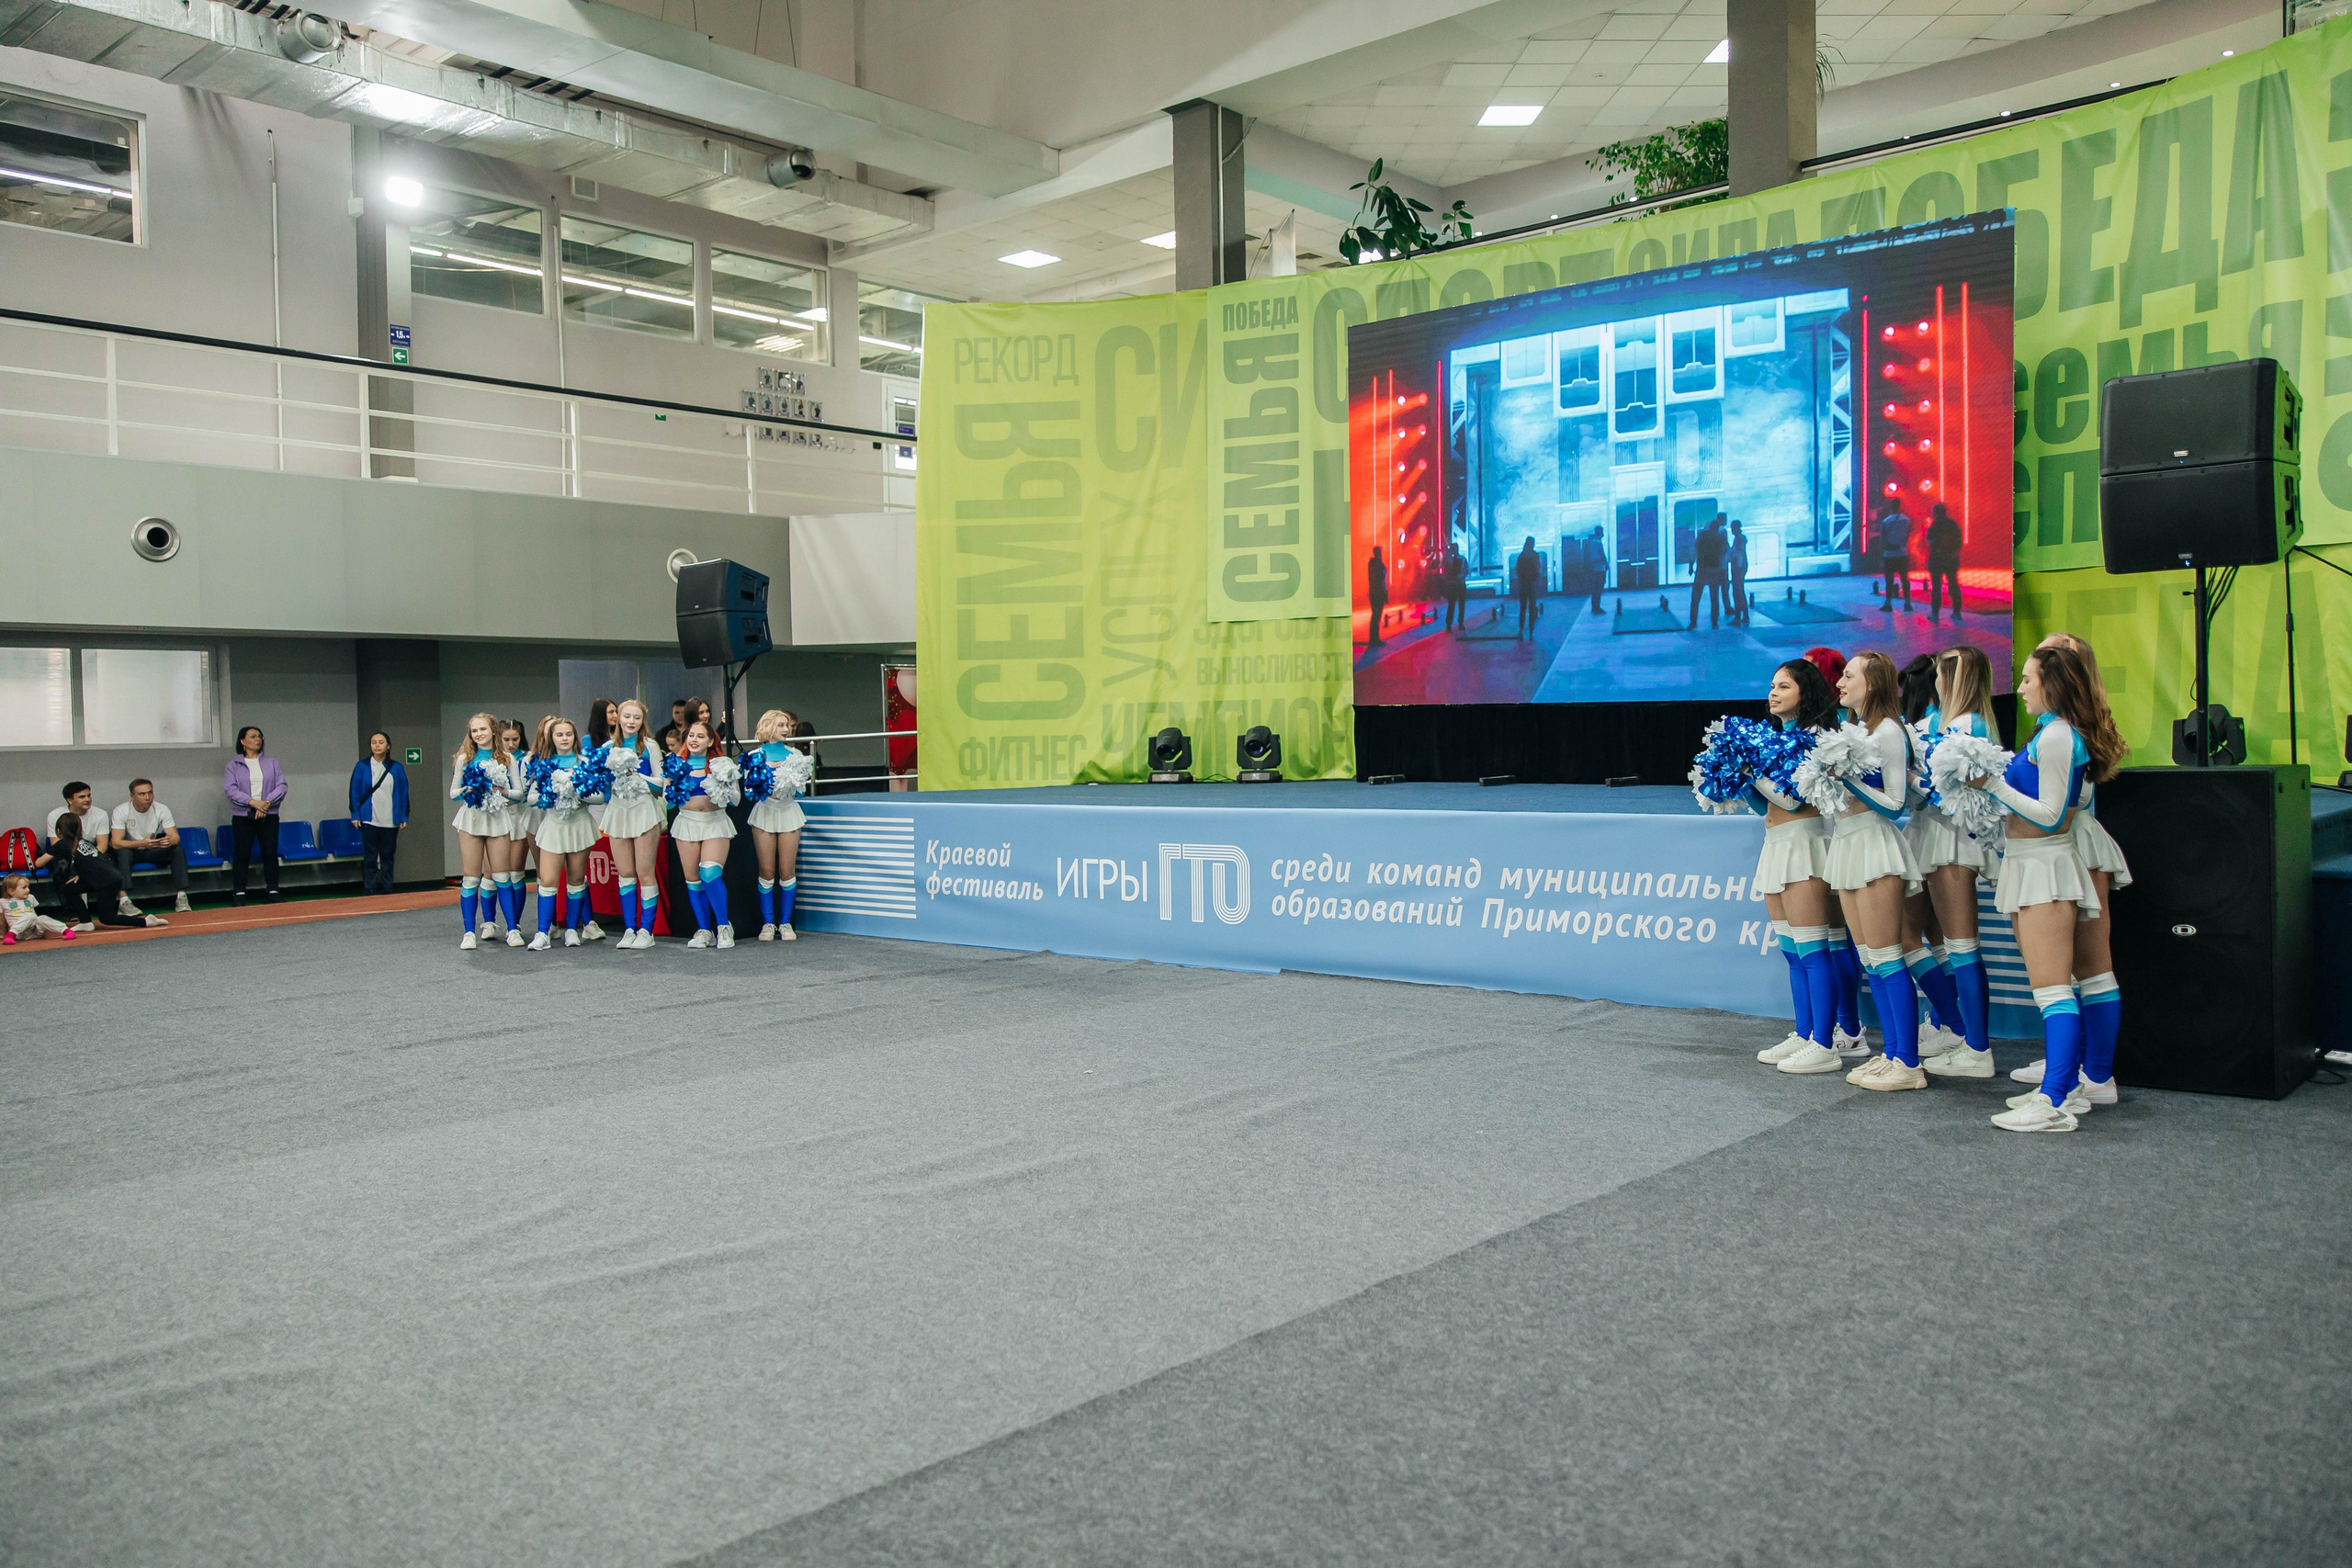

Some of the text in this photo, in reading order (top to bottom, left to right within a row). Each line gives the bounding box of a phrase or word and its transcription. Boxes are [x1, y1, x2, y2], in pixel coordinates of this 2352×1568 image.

[1820, 69, 2304, 330] БЕДА
[1223, 295, 1299, 333] ПОБЕДА
[954, 333, 1080, 387] РЕКОРД
[1094, 318, 1207, 474] СИ
[1222, 333, 1302, 603] СЕМЬЯ
[954, 400, 1087, 722] СЕМЬЯ
[1099, 485, 1180, 688] УСПЕХ
[1196, 651, 1354, 686] ВЫНОСЛИВОСТЬ
[958, 734, 1088, 782] ФИТНЕС
[925, 839, 1012, 869] Краевой
[1057, 842, 1251, 925] ИГРЫ ГТО
[1271, 852, 1351, 888] среди
[1366, 857, 1482, 889] команд
[925, 870, 1044, 901] фестиваль
[1271, 887, 1780, 956] образований Приморского кр
